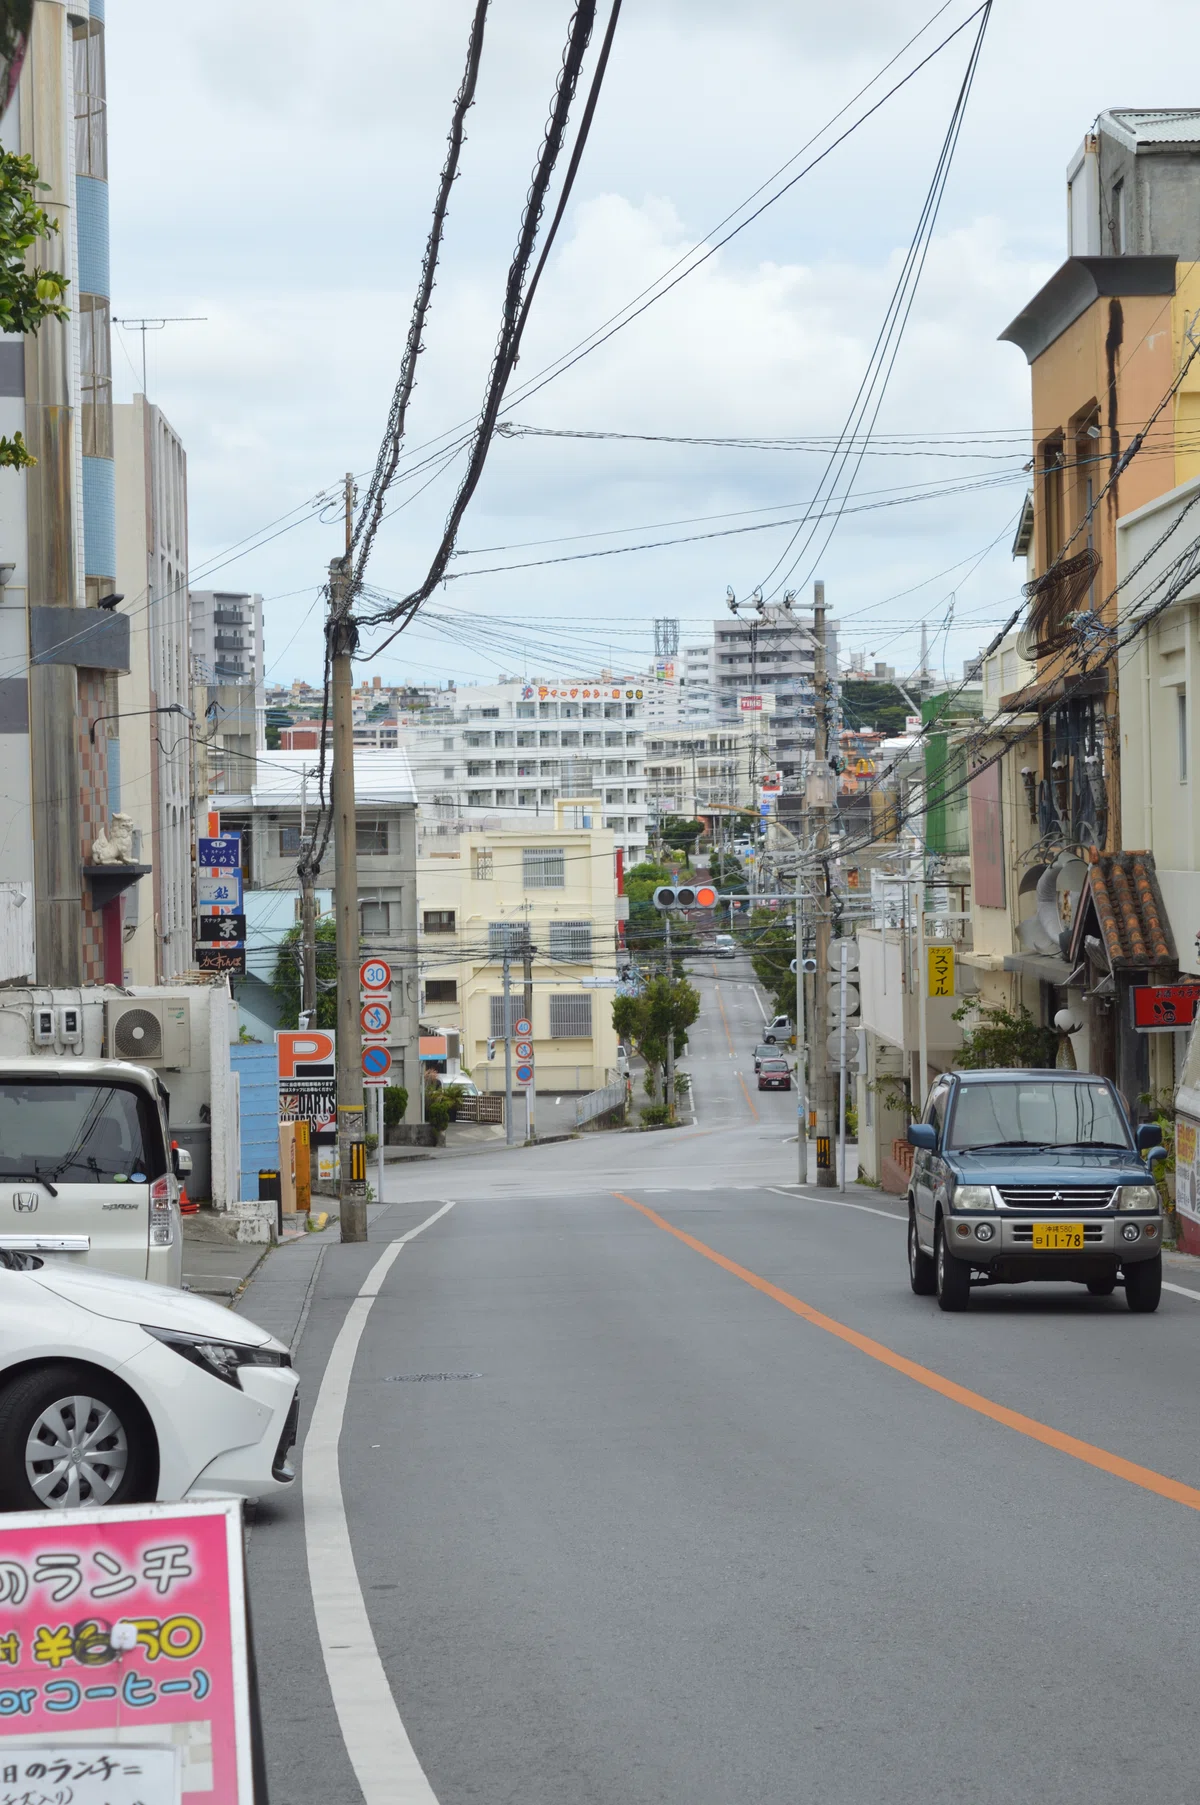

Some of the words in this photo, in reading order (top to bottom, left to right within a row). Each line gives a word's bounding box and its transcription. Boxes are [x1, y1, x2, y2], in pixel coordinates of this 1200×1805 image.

[200, 854, 236, 865] きらめき
[213, 886, 229, 900] 鮎
[219, 918, 238, 939] 京
[367, 968, 385, 982] 30
[935, 955, 949, 996] スマイル
[519, 1022, 529, 1032] 40
[277, 1032, 334, 1078] P
[298, 1094, 336, 1115] DARTS
[1046, 1233, 1081, 1248] 11-78
[0, 1545, 192, 1605] のランチ
